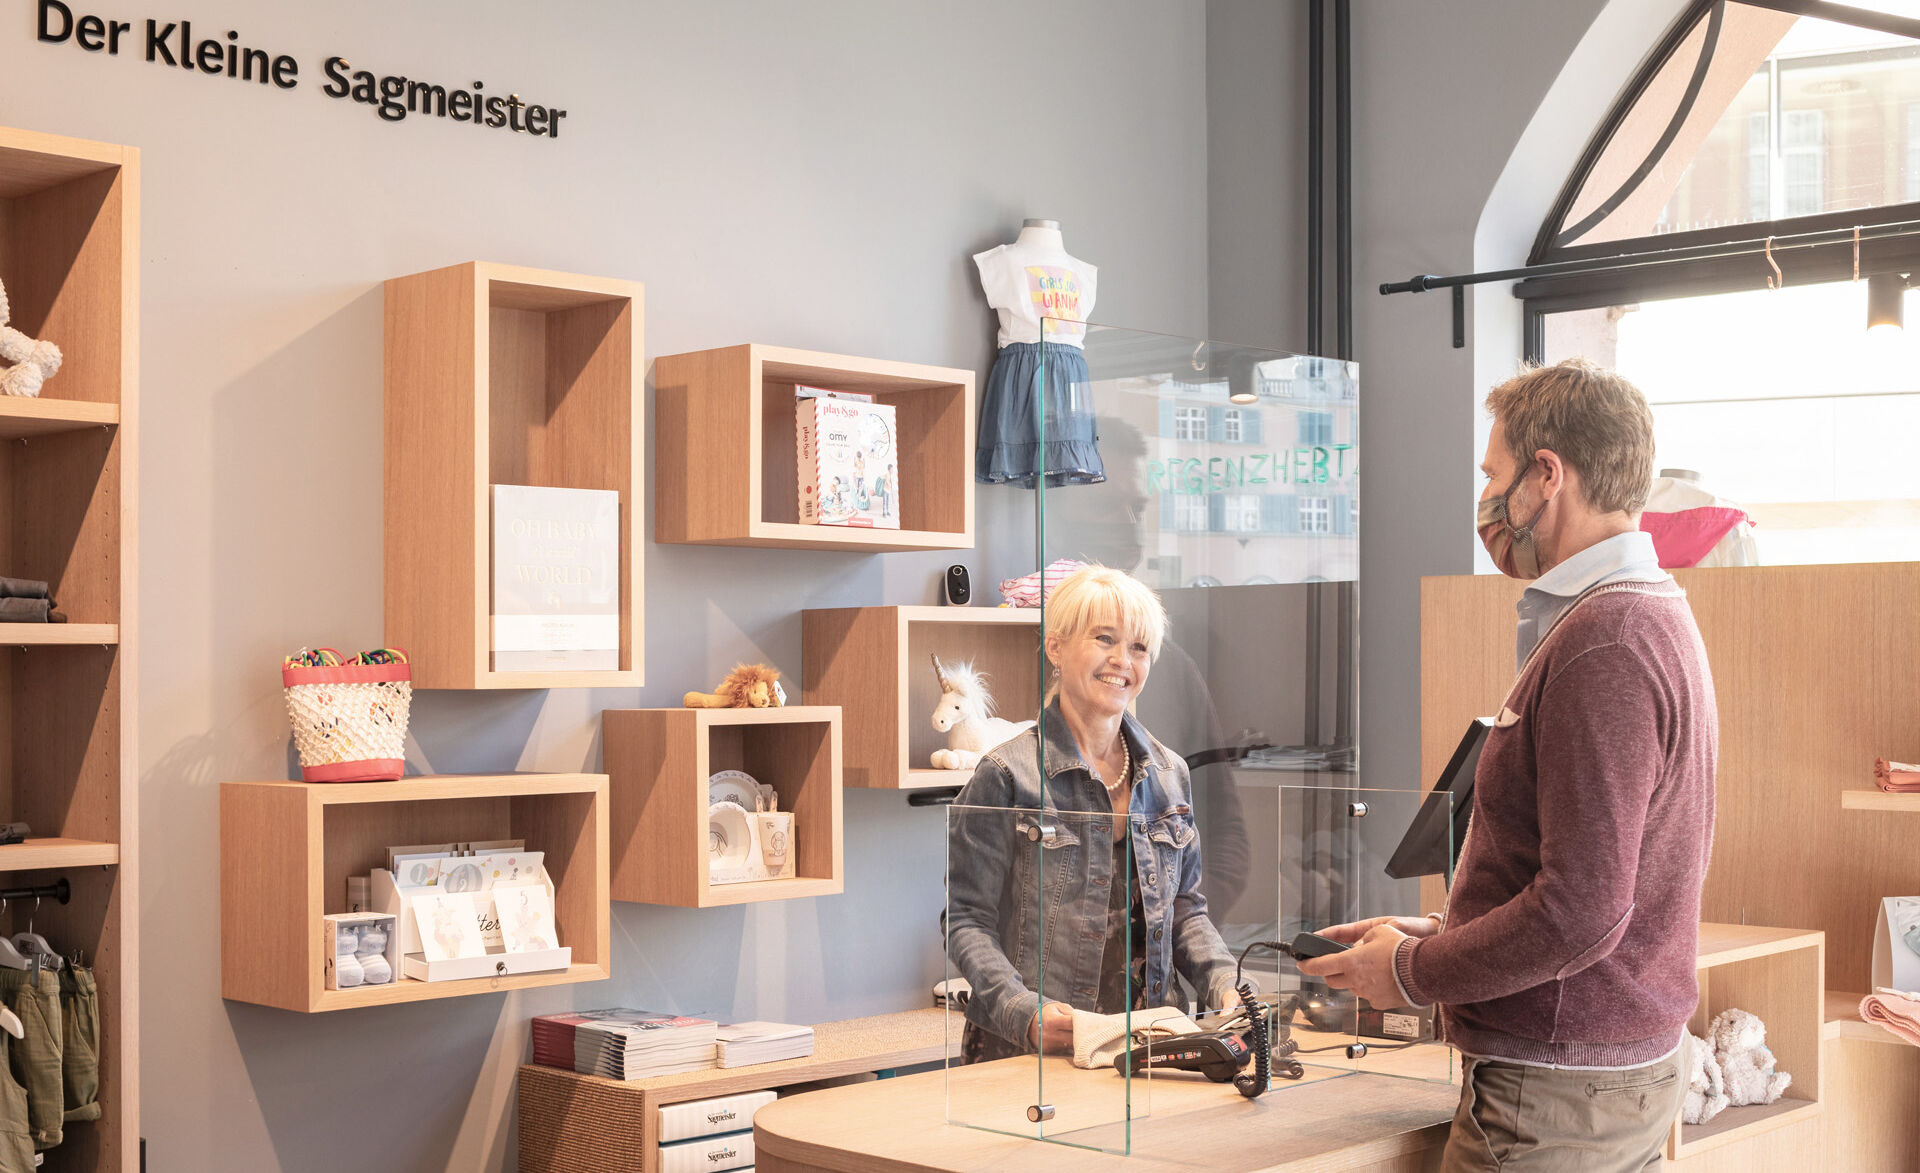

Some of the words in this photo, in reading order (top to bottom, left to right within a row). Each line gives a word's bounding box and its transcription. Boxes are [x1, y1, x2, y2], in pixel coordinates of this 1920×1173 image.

[36, 0, 130, 54] Der
[146, 18, 299, 89] Kleine
[322, 57, 567, 138] Sagmeister
[823, 403, 858, 418] play&go
[515, 565, 592, 584] WORLD
